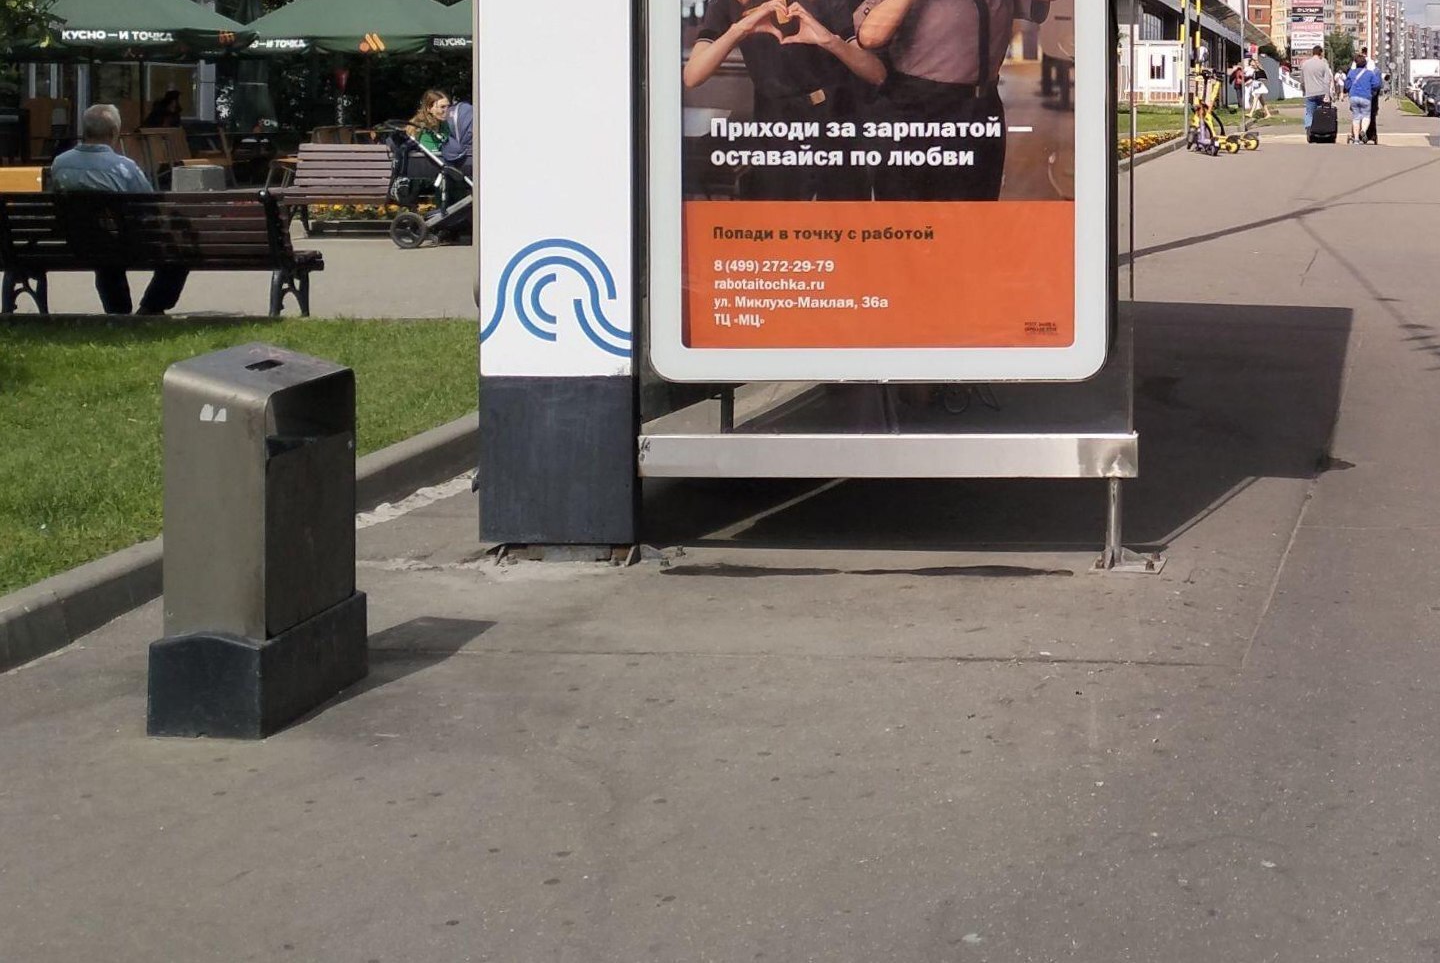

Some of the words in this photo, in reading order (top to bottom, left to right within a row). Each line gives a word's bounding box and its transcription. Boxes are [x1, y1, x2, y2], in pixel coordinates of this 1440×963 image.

[131, 31, 174, 42] ТОЧКА
[710, 117, 820, 142] Приходи
[825, 122, 856, 138] за
[862, 116, 1001, 142] зарплатой
[710, 144, 844, 166] оставайся
[850, 150, 882, 166] по
[887, 146, 974, 166] любви
[713, 226, 773, 241] Попади
[779, 229, 788, 240] в
[792, 228, 844, 243] точку
[847, 229, 857, 240] с
[861, 226, 934, 243] работой
[714, 260, 723, 272] 8
[725, 260, 759, 274] (499)
[762, 260, 835, 273] 272-29-79
[714, 278, 825, 290] rabotaitochka.ru
[714, 299, 731, 309] ул.
[735, 296, 858, 310] Миклухо-Маклая,
[862, 296, 889, 308] 36а
[714, 314, 731, 327] ТЦ
